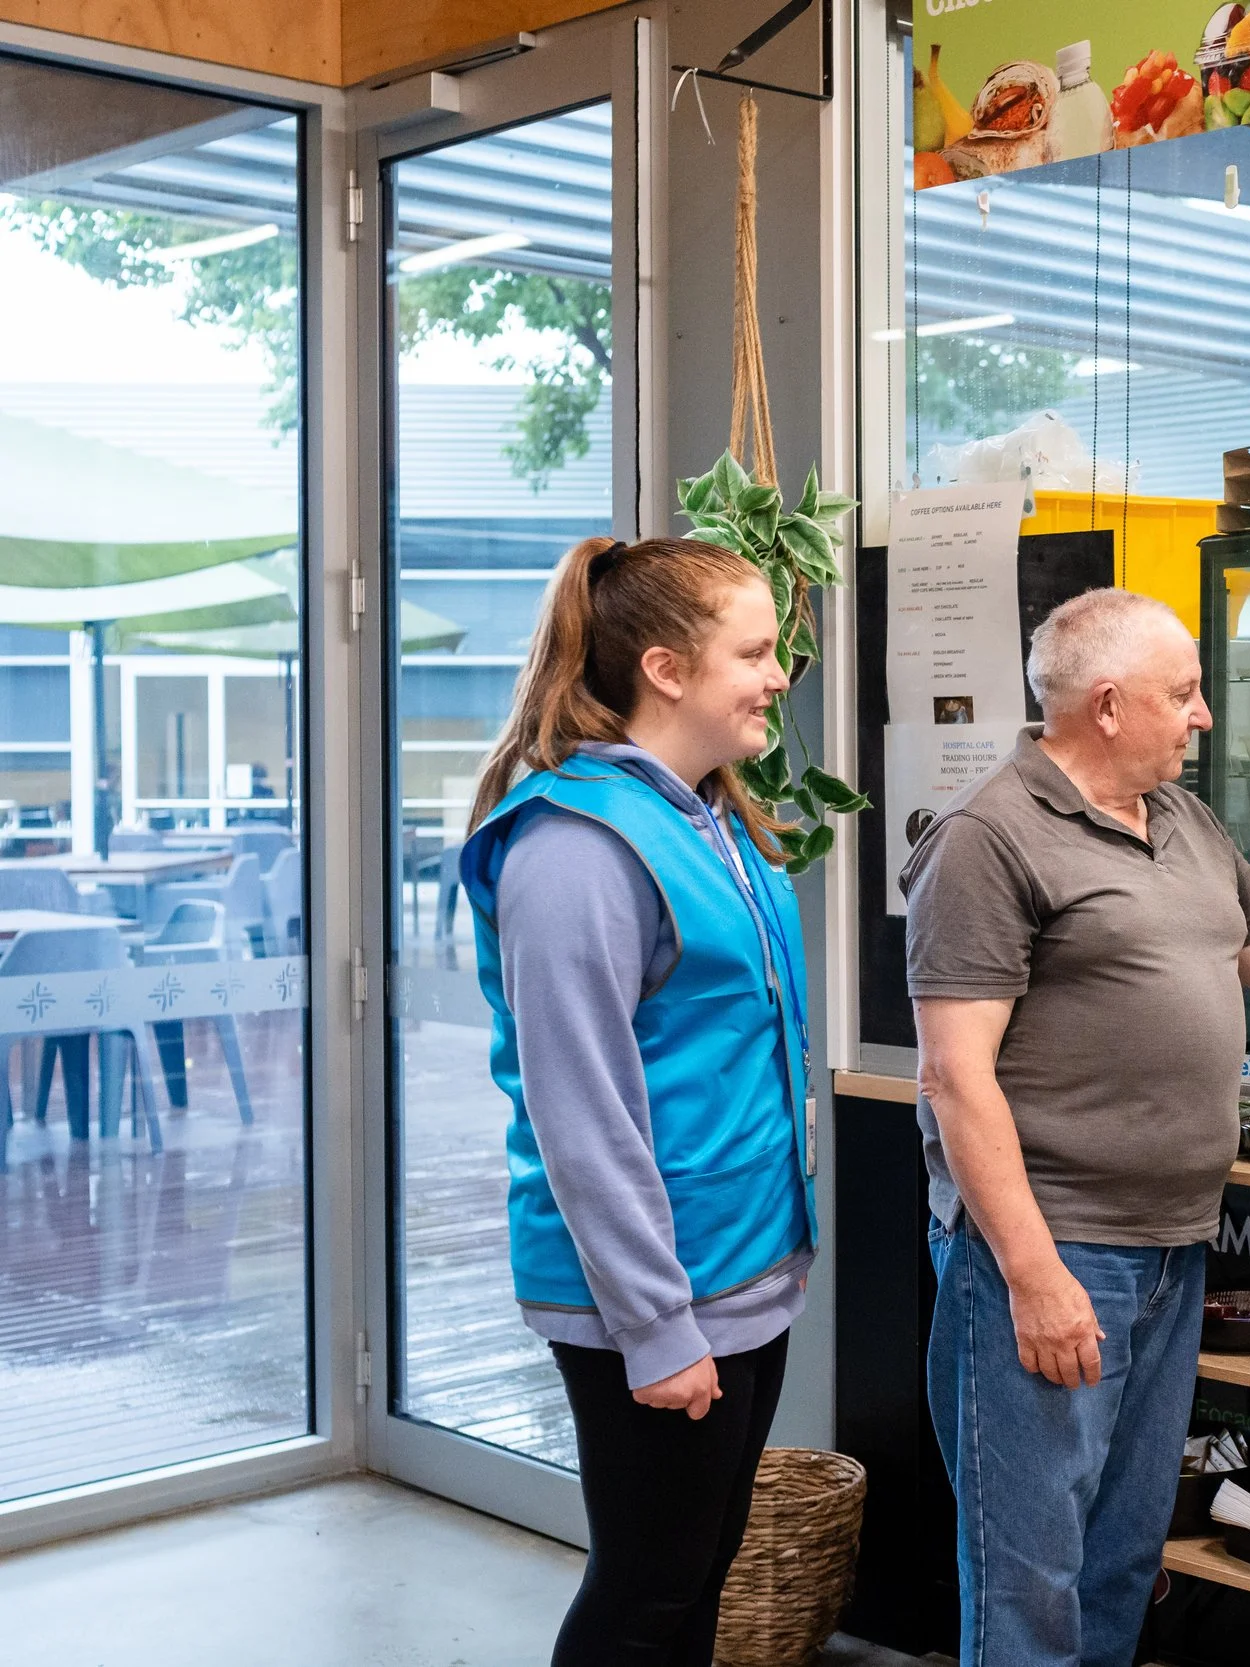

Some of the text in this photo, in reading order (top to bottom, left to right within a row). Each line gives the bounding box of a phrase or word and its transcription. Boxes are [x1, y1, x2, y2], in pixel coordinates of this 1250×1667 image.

[911, 501, 1002, 516] COFFEE OPTIONS AVAILABLE HERE
[943, 741, 975, 750] HOSPITAL
[942, 754, 998, 762] TRADING HOURS
[940, 766, 968, 774] MONDAY
